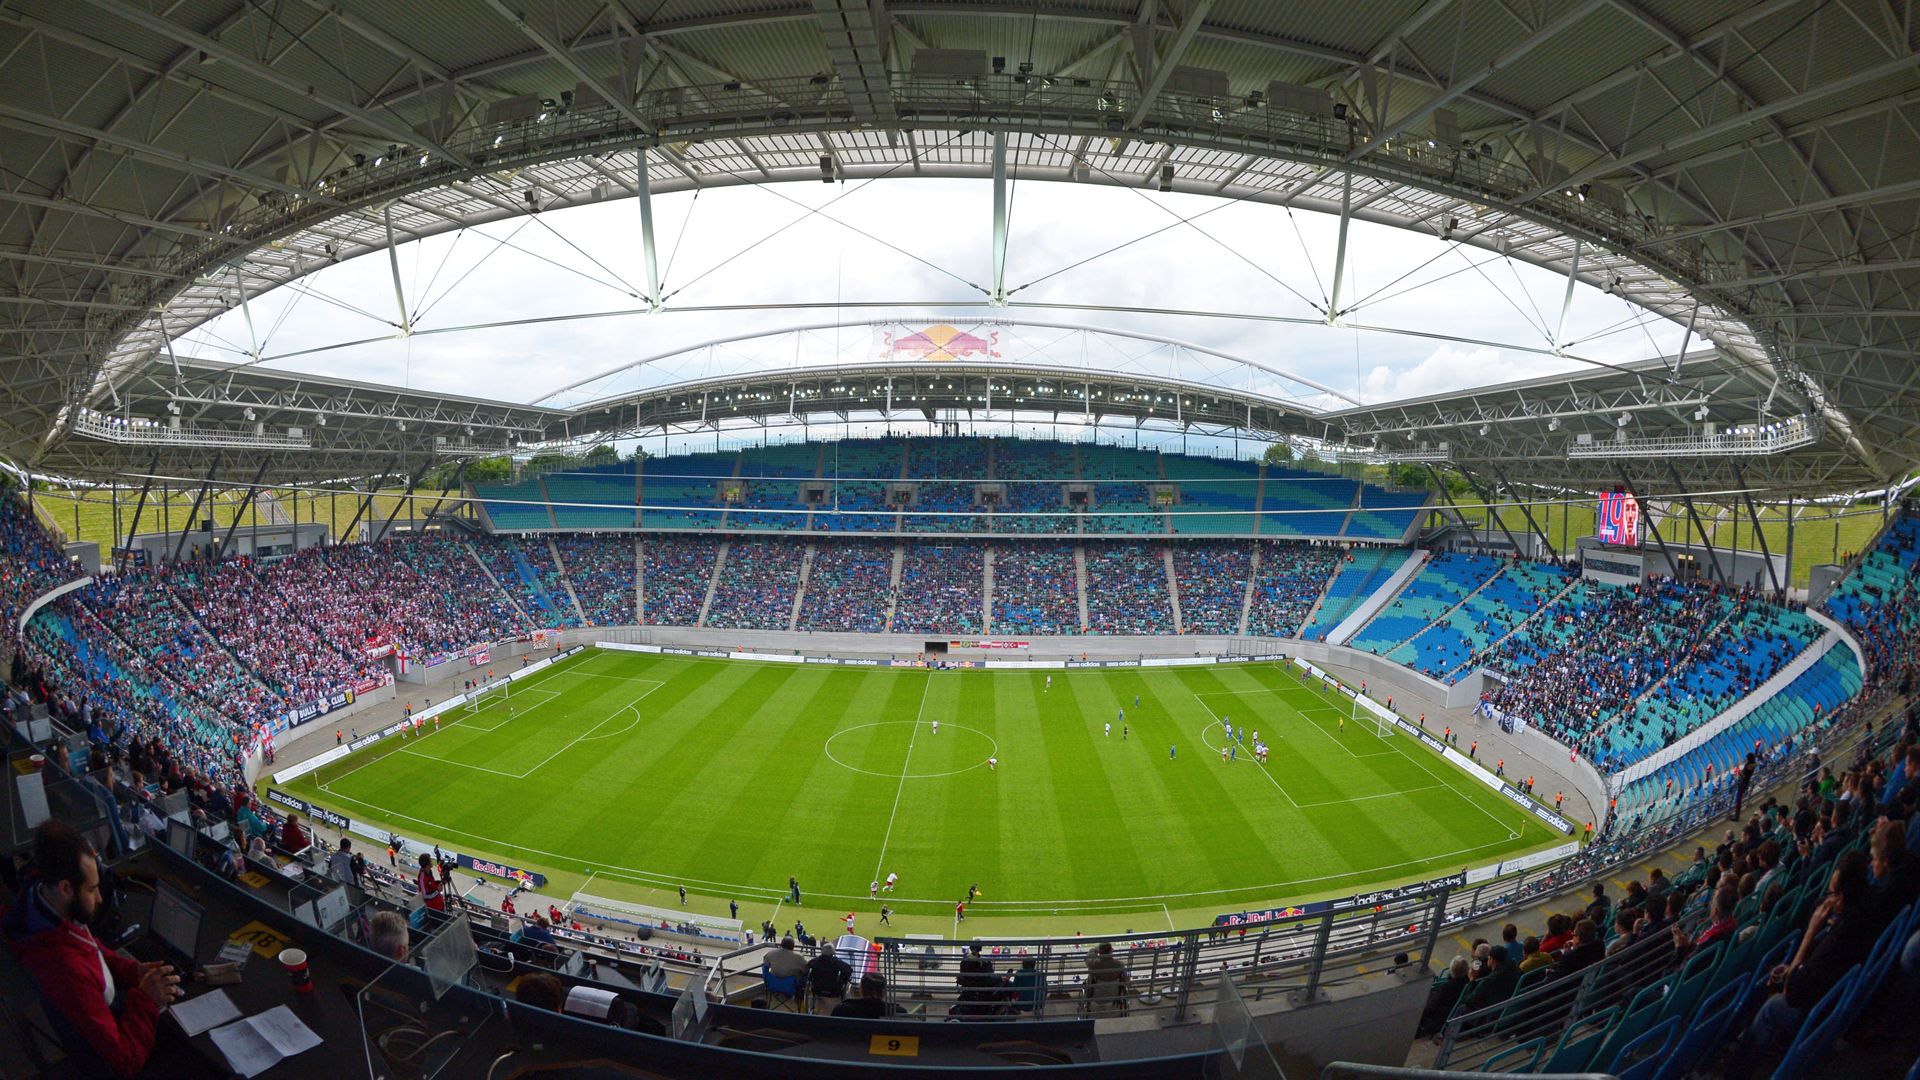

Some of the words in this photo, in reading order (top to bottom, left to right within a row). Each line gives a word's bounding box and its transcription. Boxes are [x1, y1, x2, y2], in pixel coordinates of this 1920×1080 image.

[299, 705, 317, 719] BULLS
[331, 693, 346, 706] CLUB
[281, 796, 303, 811] adidas
[1513, 793, 1533, 809] adidas
[1548, 815, 1569, 832] adidas
[888, 1040, 900, 1051] 9
